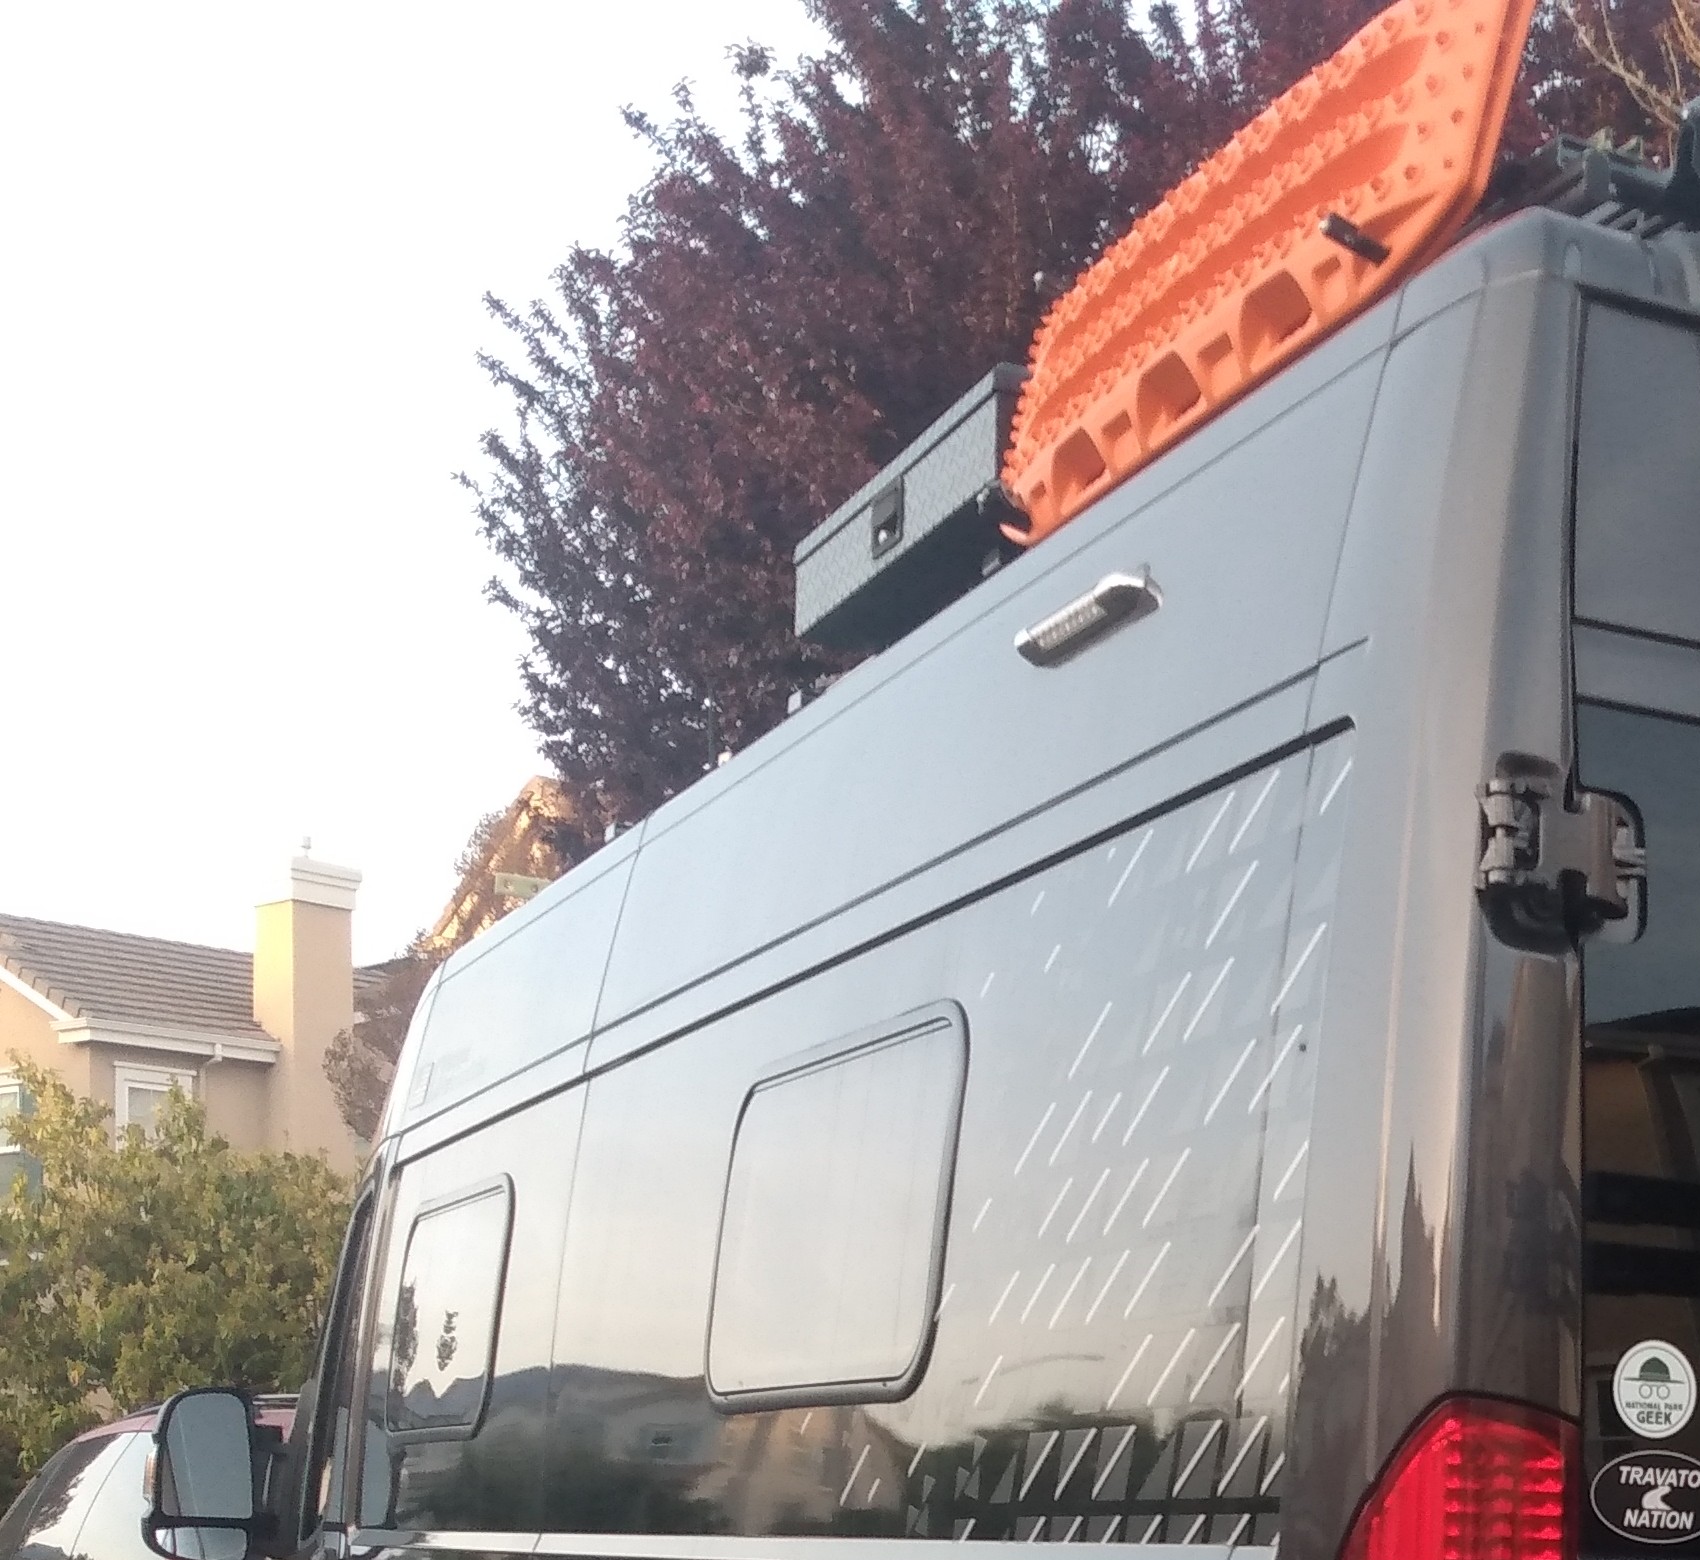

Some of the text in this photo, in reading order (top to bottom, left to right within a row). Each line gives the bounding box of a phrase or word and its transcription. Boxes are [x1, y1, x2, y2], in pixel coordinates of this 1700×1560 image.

[1625, 1401, 1661, 1411] NATIONAL
[1636, 1410, 1672, 1425] GEEK
[1623, 1508, 1695, 1530] NATION
